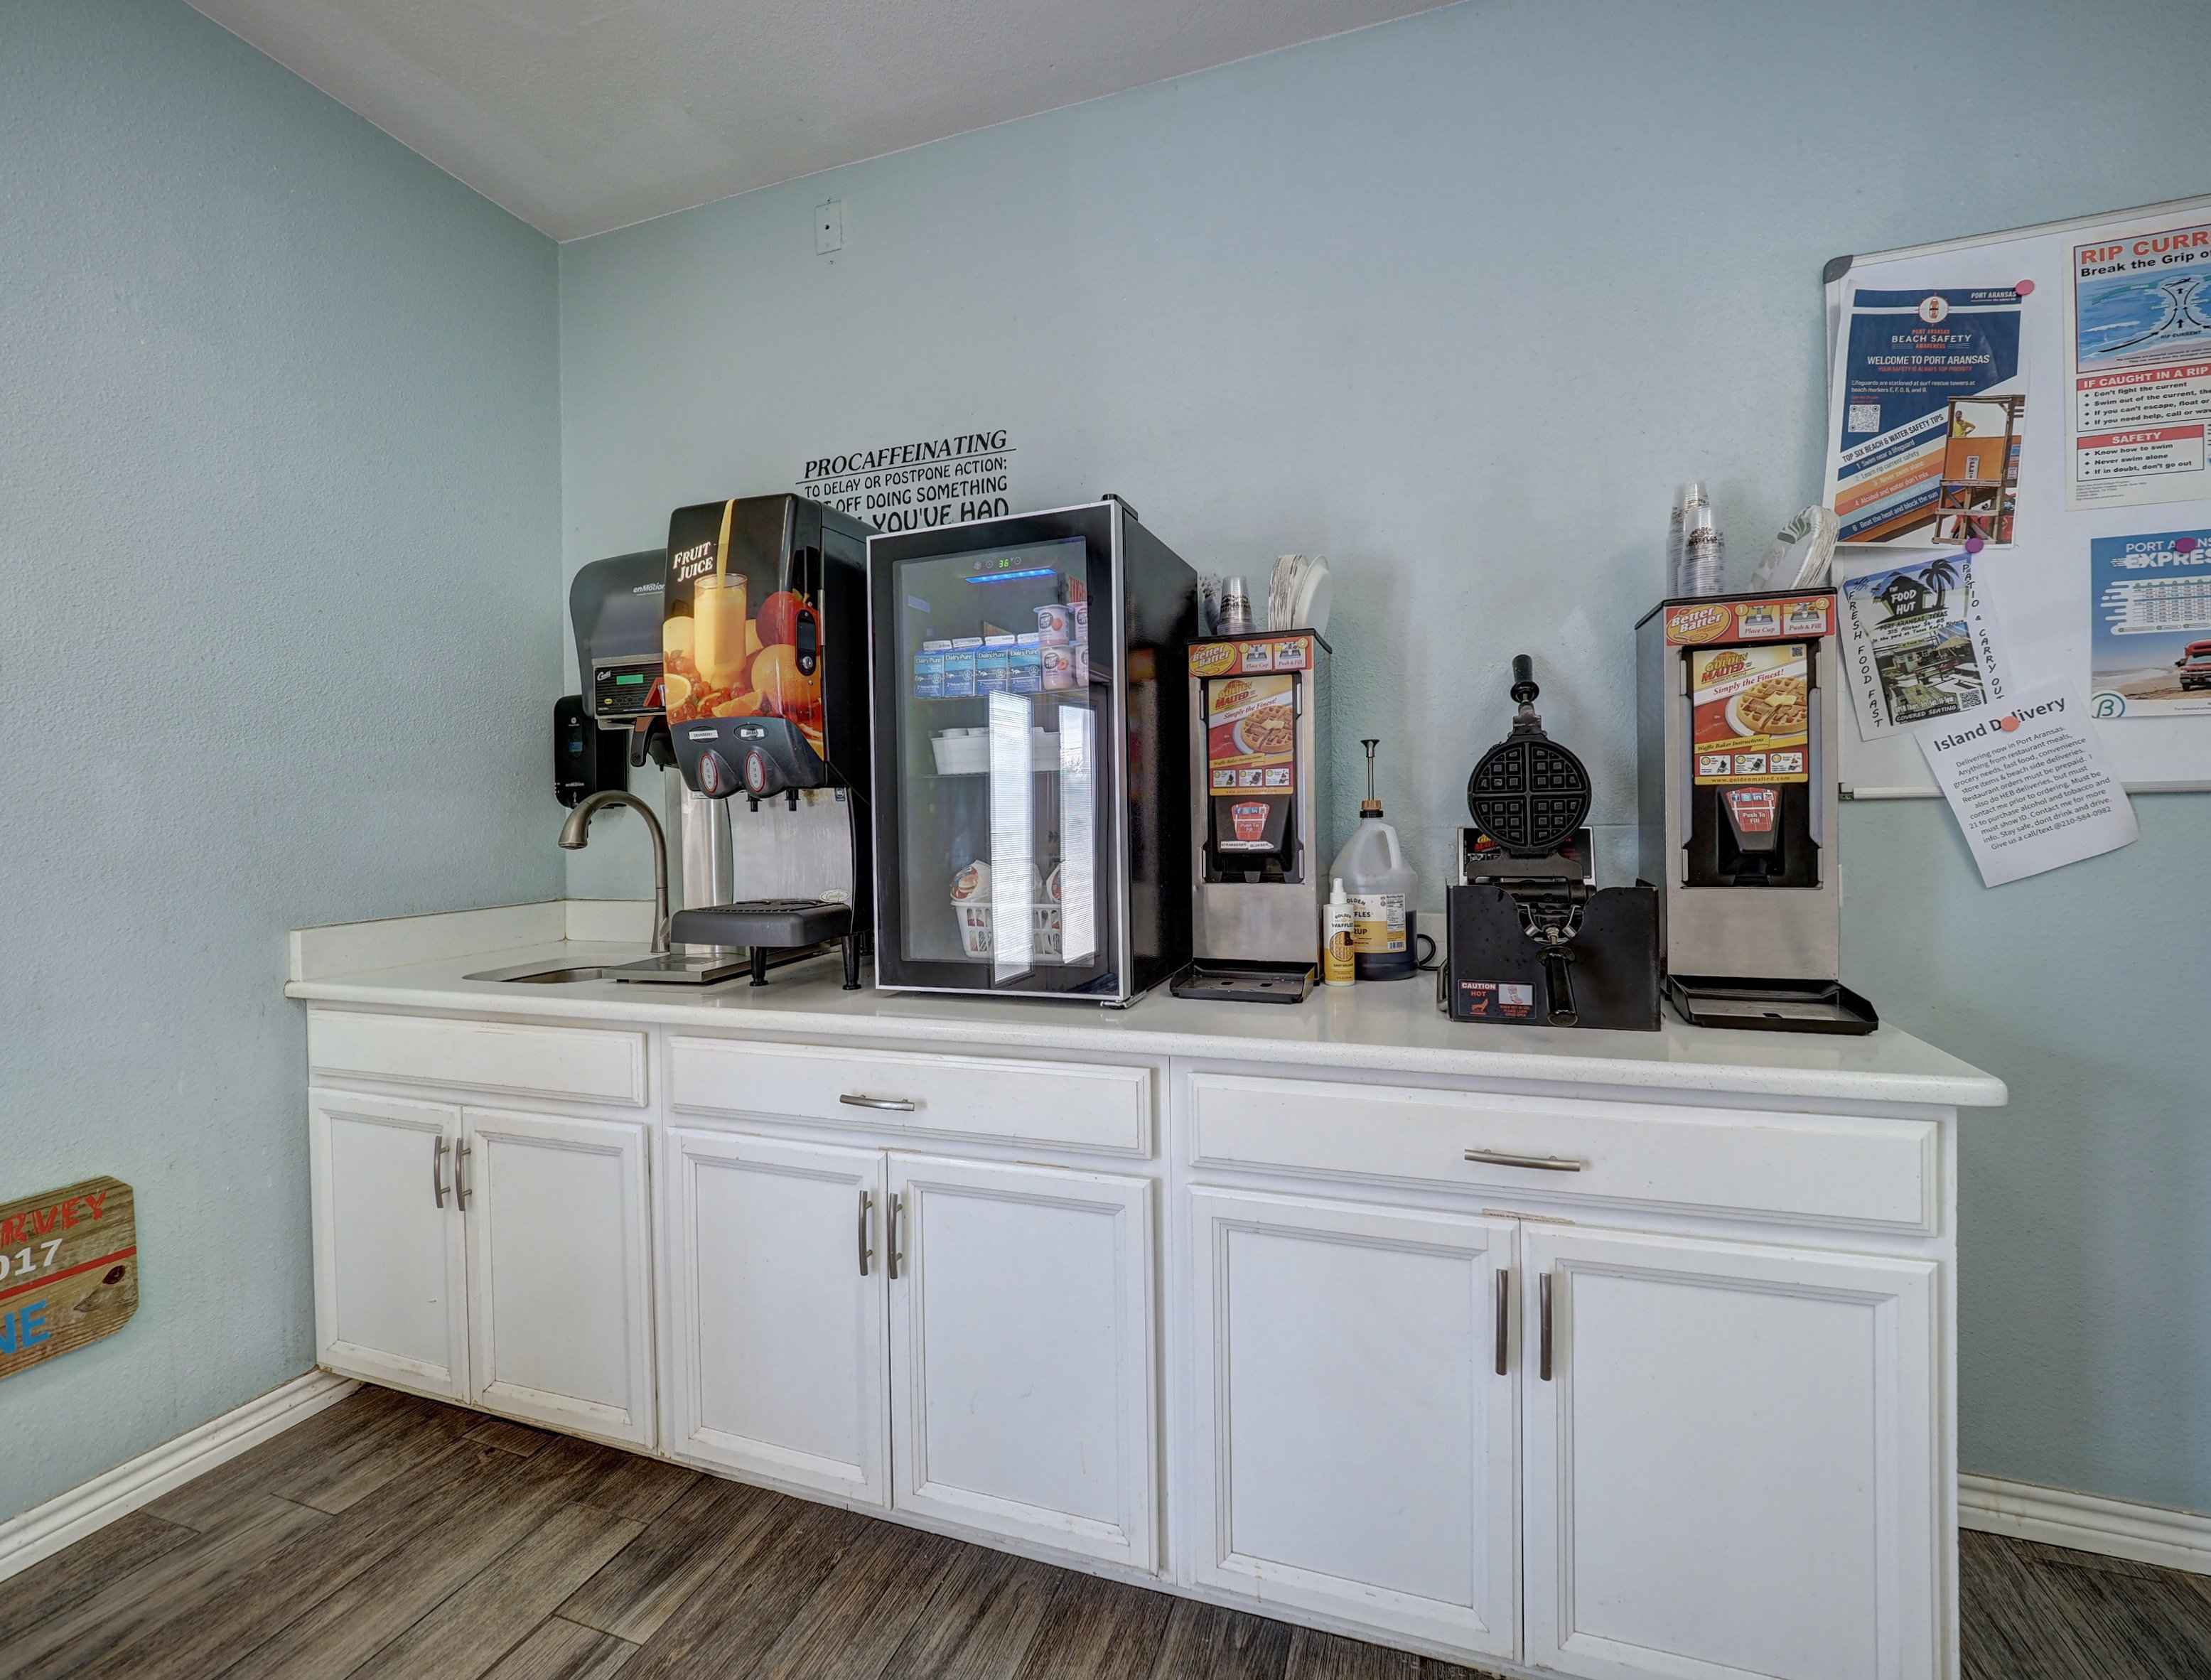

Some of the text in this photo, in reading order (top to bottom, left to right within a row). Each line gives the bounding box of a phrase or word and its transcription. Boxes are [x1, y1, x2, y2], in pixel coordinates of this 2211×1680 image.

[2081, 231, 2211, 264] RIP CURR
[2081, 252, 2195, 277] Break the Grip
[1988, 290, 2017, 298] ARANSAS
[1891, 334, 1972, 343] BEACH SAFETY
[1867, 355, 1990, 365] WELCOME TO PORT ARANSAS
[2099, 372, 2153, 387] CAUGHT
[2156, 370, 2170, 379] IN
[2187, 367, 2208, 376] RIP
[2094, 398, 2117, 406] Swim
[2163, 390, 2197, 399] current,
[2118, 387, 2137, 395] fight
[2156, 382, 2188, 390] current
[2143, 402, 2177, 410] escape,
[1842, 453, 1854, 463] TOP
[1854, 448, 1865, 458] SIX
[1864, 440, 1883, 453] BEACH
[1888, 429, 1910, 443] WATER
[1909, 420, 1930, 434] SAFETY
[1930, 414, 1944, 426] TIPS
[2112, 431, 2161, 444] SAFETY
[804, 429, 1007, 479] PROCAFFEINATING
[805, 457, 1007, 499] TO DELAY OR POSTPONE ACTION:
[2113, 464, 2139, 473] doubt,
[836, 475, 1007, 512] OFF DOING SOMETHING
[873, 497, 1009, 533] YOU'VE HAD
[672, 541, 711, 569] FRUIT
[2126, 540, 2164, 553] PORT
[677, 556, 714, 582] JUICE
[999, 559, 1010, 568] 36
[2126, 549, 2211, 569] EXPRES
[1890, 589, 1917, 604] FOOD
[1672, 608, 1714, 628] Better
[1896, 601, 1916, 615] HUT
[1679, 612, 1722, 633] Batter
[1762, 626, 1775, 635] Cup
[1193, 645, 1225, 660] Better
[1701, 662, 1745, 684] MALTED
[1857, 645, 1872, 684] FOOD
[1714, 668, 1785, 694] Simply the Finest!
[1928, 705, 1957, 715] SEATING
[1934, 697, 2065, 752] Island Dlivery
[1956, 752, 1991, 767] Delivering
[1959, 763, 1989, 775] Anything
[2008, 742, 2045, 758] restaurant
[1962, 787, 1998, 802] Restaurant
[2001, 779, 2023, 789] orders
[2024, 771, 2042, 780] must
[1988, 809, 2018, 823] purchase
[2021, 798, 2047, 811] alcohol
[2063, 784, 2093, 795] tobacco
[2096, 777, 2109, 785] and
[1346, 898, 1366, 906] OLDEN
[0, 1189, 107, 1249] RVEY
